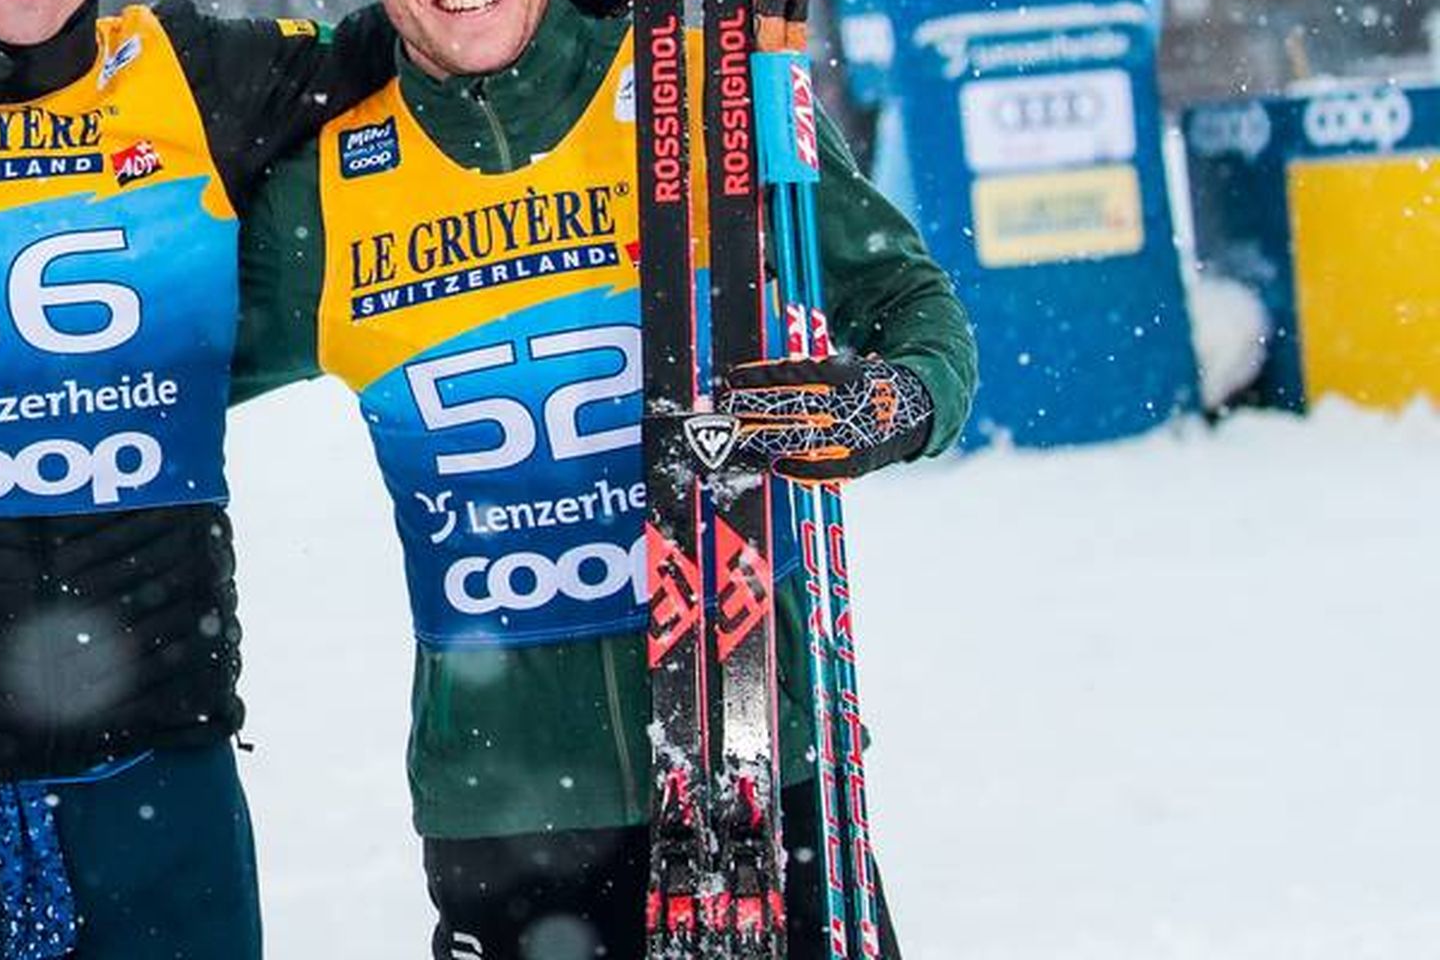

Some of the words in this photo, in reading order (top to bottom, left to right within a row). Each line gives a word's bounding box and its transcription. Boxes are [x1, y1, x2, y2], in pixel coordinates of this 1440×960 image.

[652, 15, 680, 203] ROSSIGNOL
[719, 8, 751, 196] ROSSIGNOL
[1303, 88, 1413, 154] coop
[349, 151, 392, 170] coop
[350, 232, 396, 291] LE
[361, 247, 607, 316] SWITZERLAND
[404, 322, 644, 476] 52
[467, 470, 647, 534] Lenzerhe
